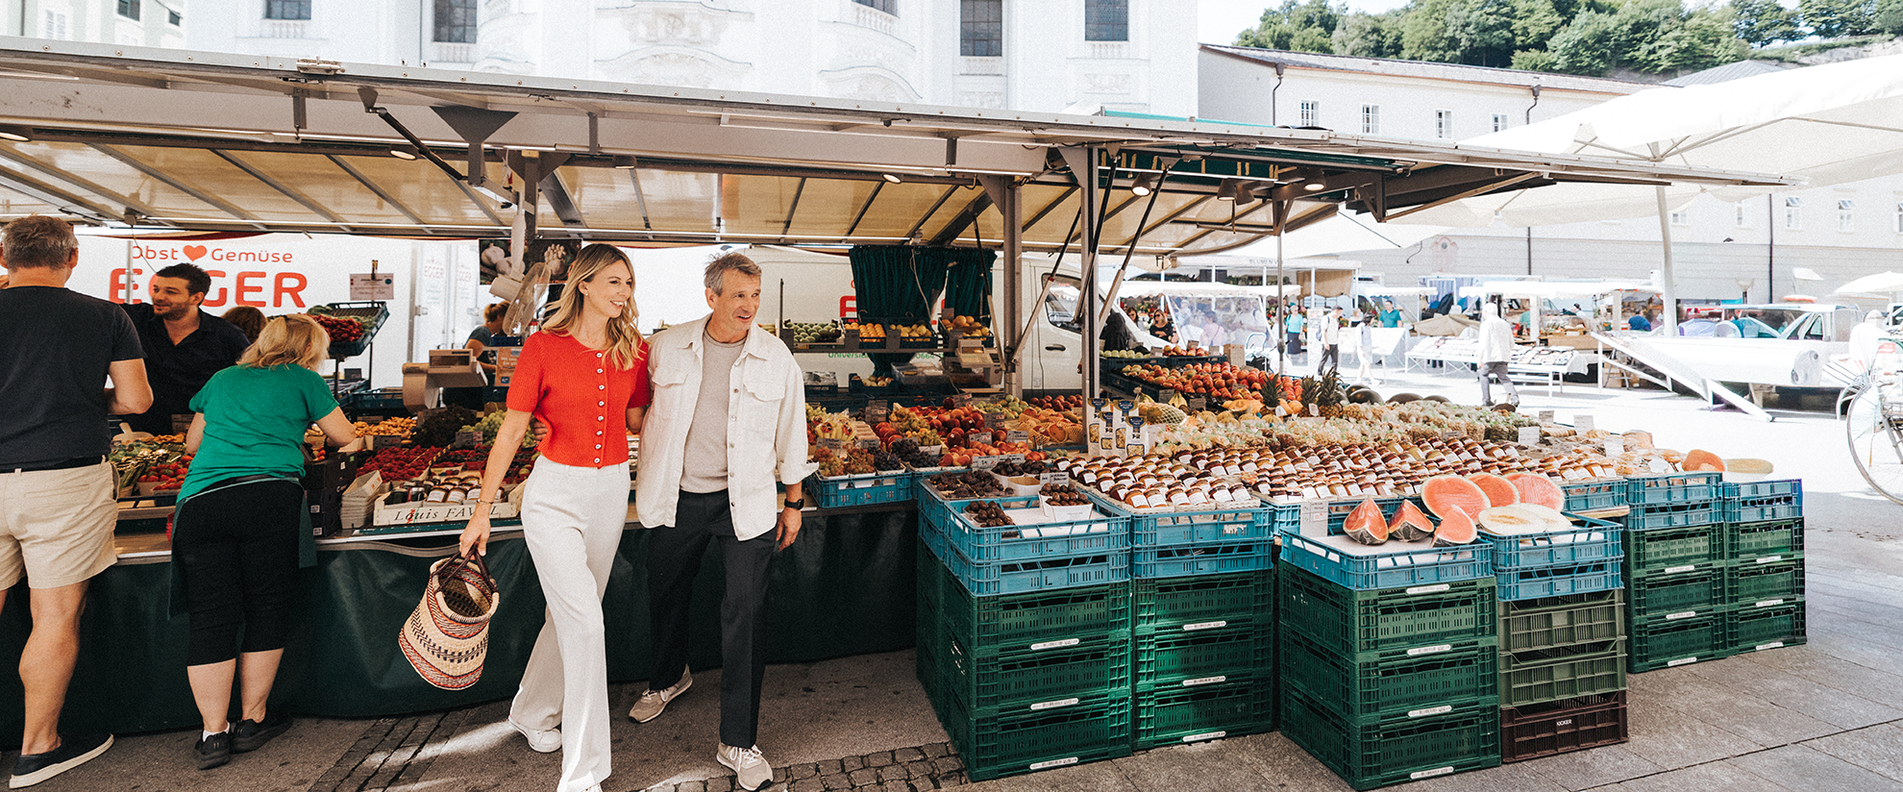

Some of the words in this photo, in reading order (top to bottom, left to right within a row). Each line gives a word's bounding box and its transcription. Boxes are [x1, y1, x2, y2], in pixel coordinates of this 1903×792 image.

[211, 248, 293, 263] Gemüse
[108, 268, 308, 308] EGER
[394, 508, 439, 521] Louis
